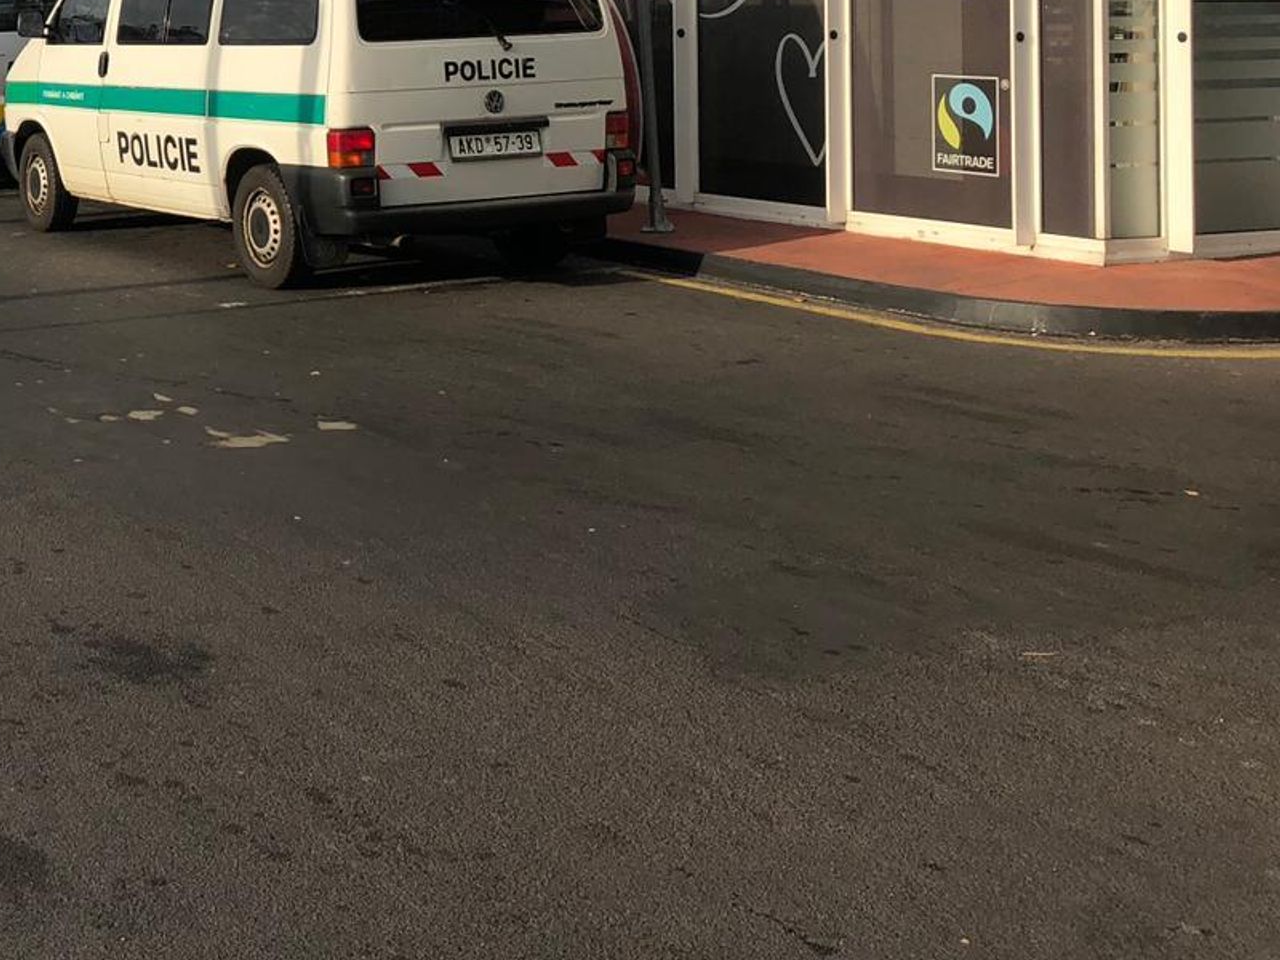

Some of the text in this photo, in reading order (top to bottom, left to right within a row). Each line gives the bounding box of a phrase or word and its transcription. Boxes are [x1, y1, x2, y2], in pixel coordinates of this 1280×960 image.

[444, 58, 536, 82] POLICIE
[116, 130, 202, 174] POLICIE
[459, 137, 484, 155] AKD
[937, 152, 994, 169] FAIRTRADE
